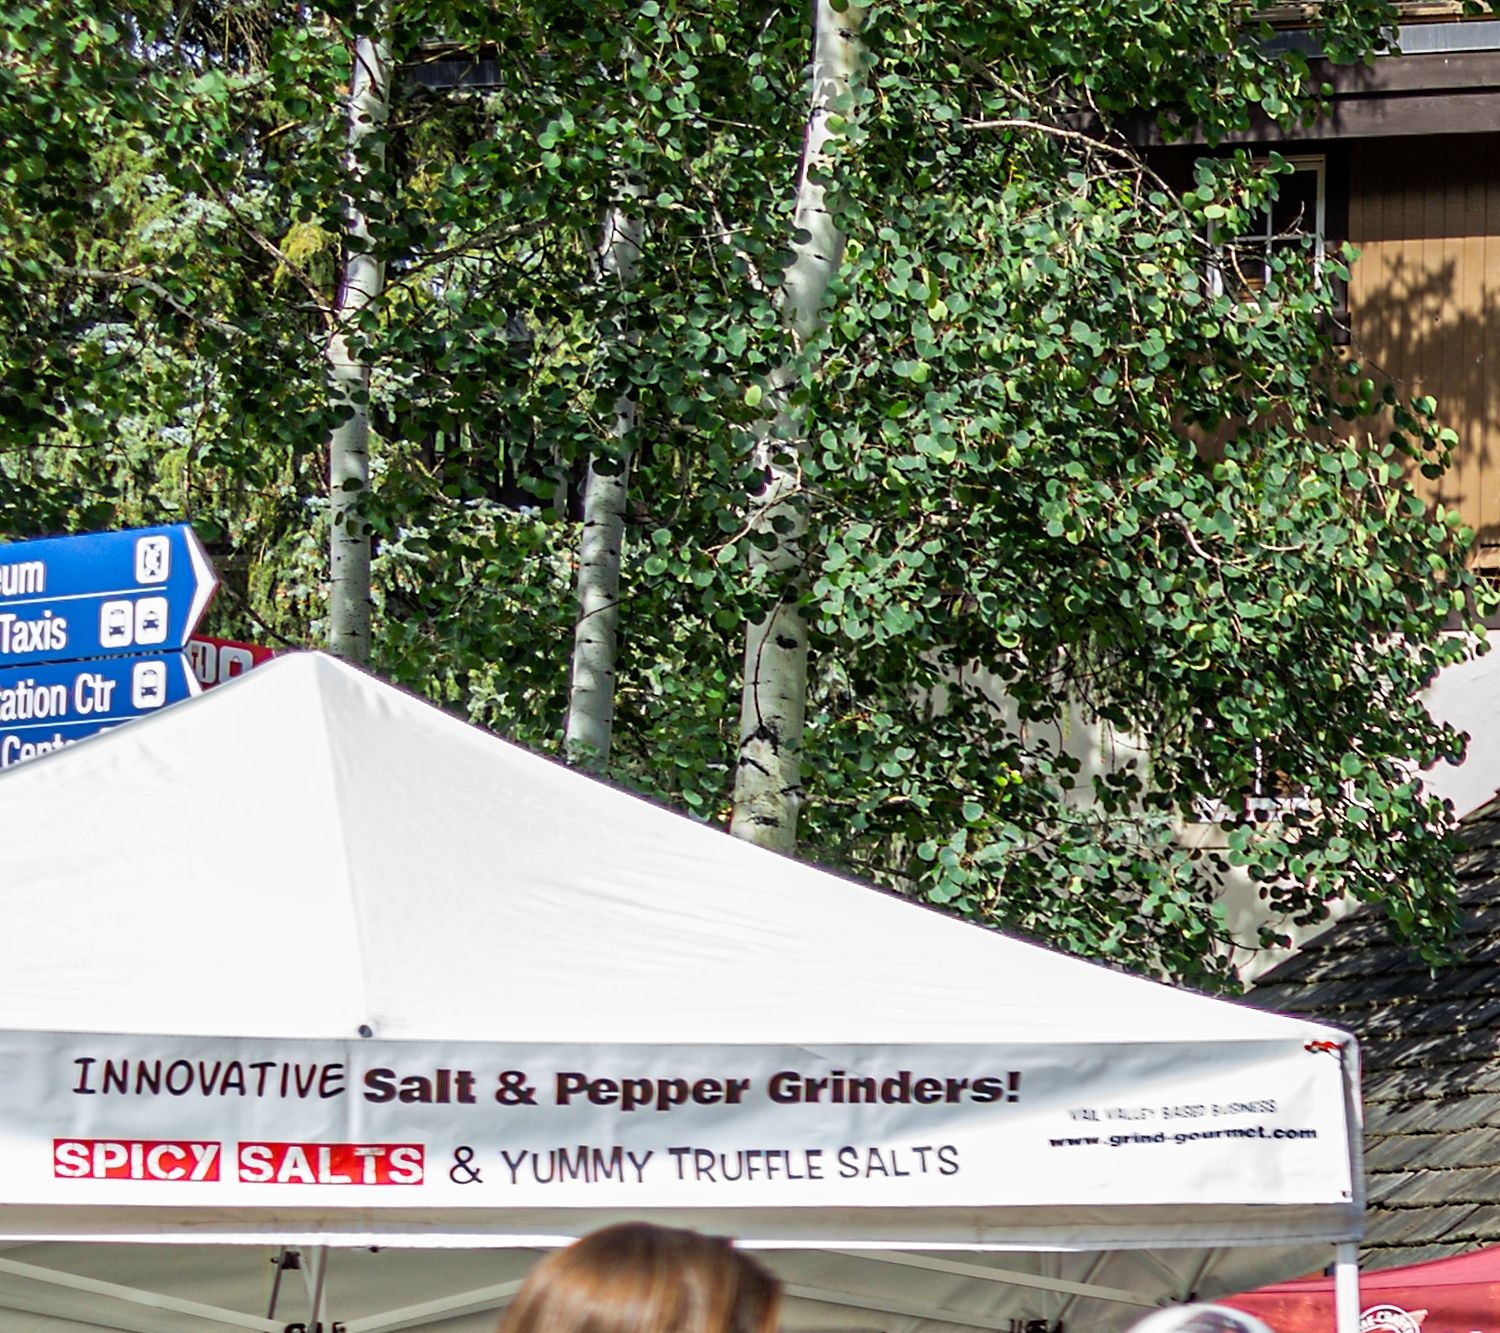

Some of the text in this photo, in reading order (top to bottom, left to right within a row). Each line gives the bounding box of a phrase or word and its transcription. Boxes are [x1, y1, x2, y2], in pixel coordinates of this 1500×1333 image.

[0, 610, 67, 655] Taxis
[74, 672, 116, 715] Ctr
[72, 1057, 1023, 1111] INNOVATIVE Salt & Pepper Grinders!
[1049, 1125, 1318, 1147] www.grind-gourmet.com
[55, 1142, 960, 1185] SPICY SALTS & YUMMY TRUFFLE SALTS
